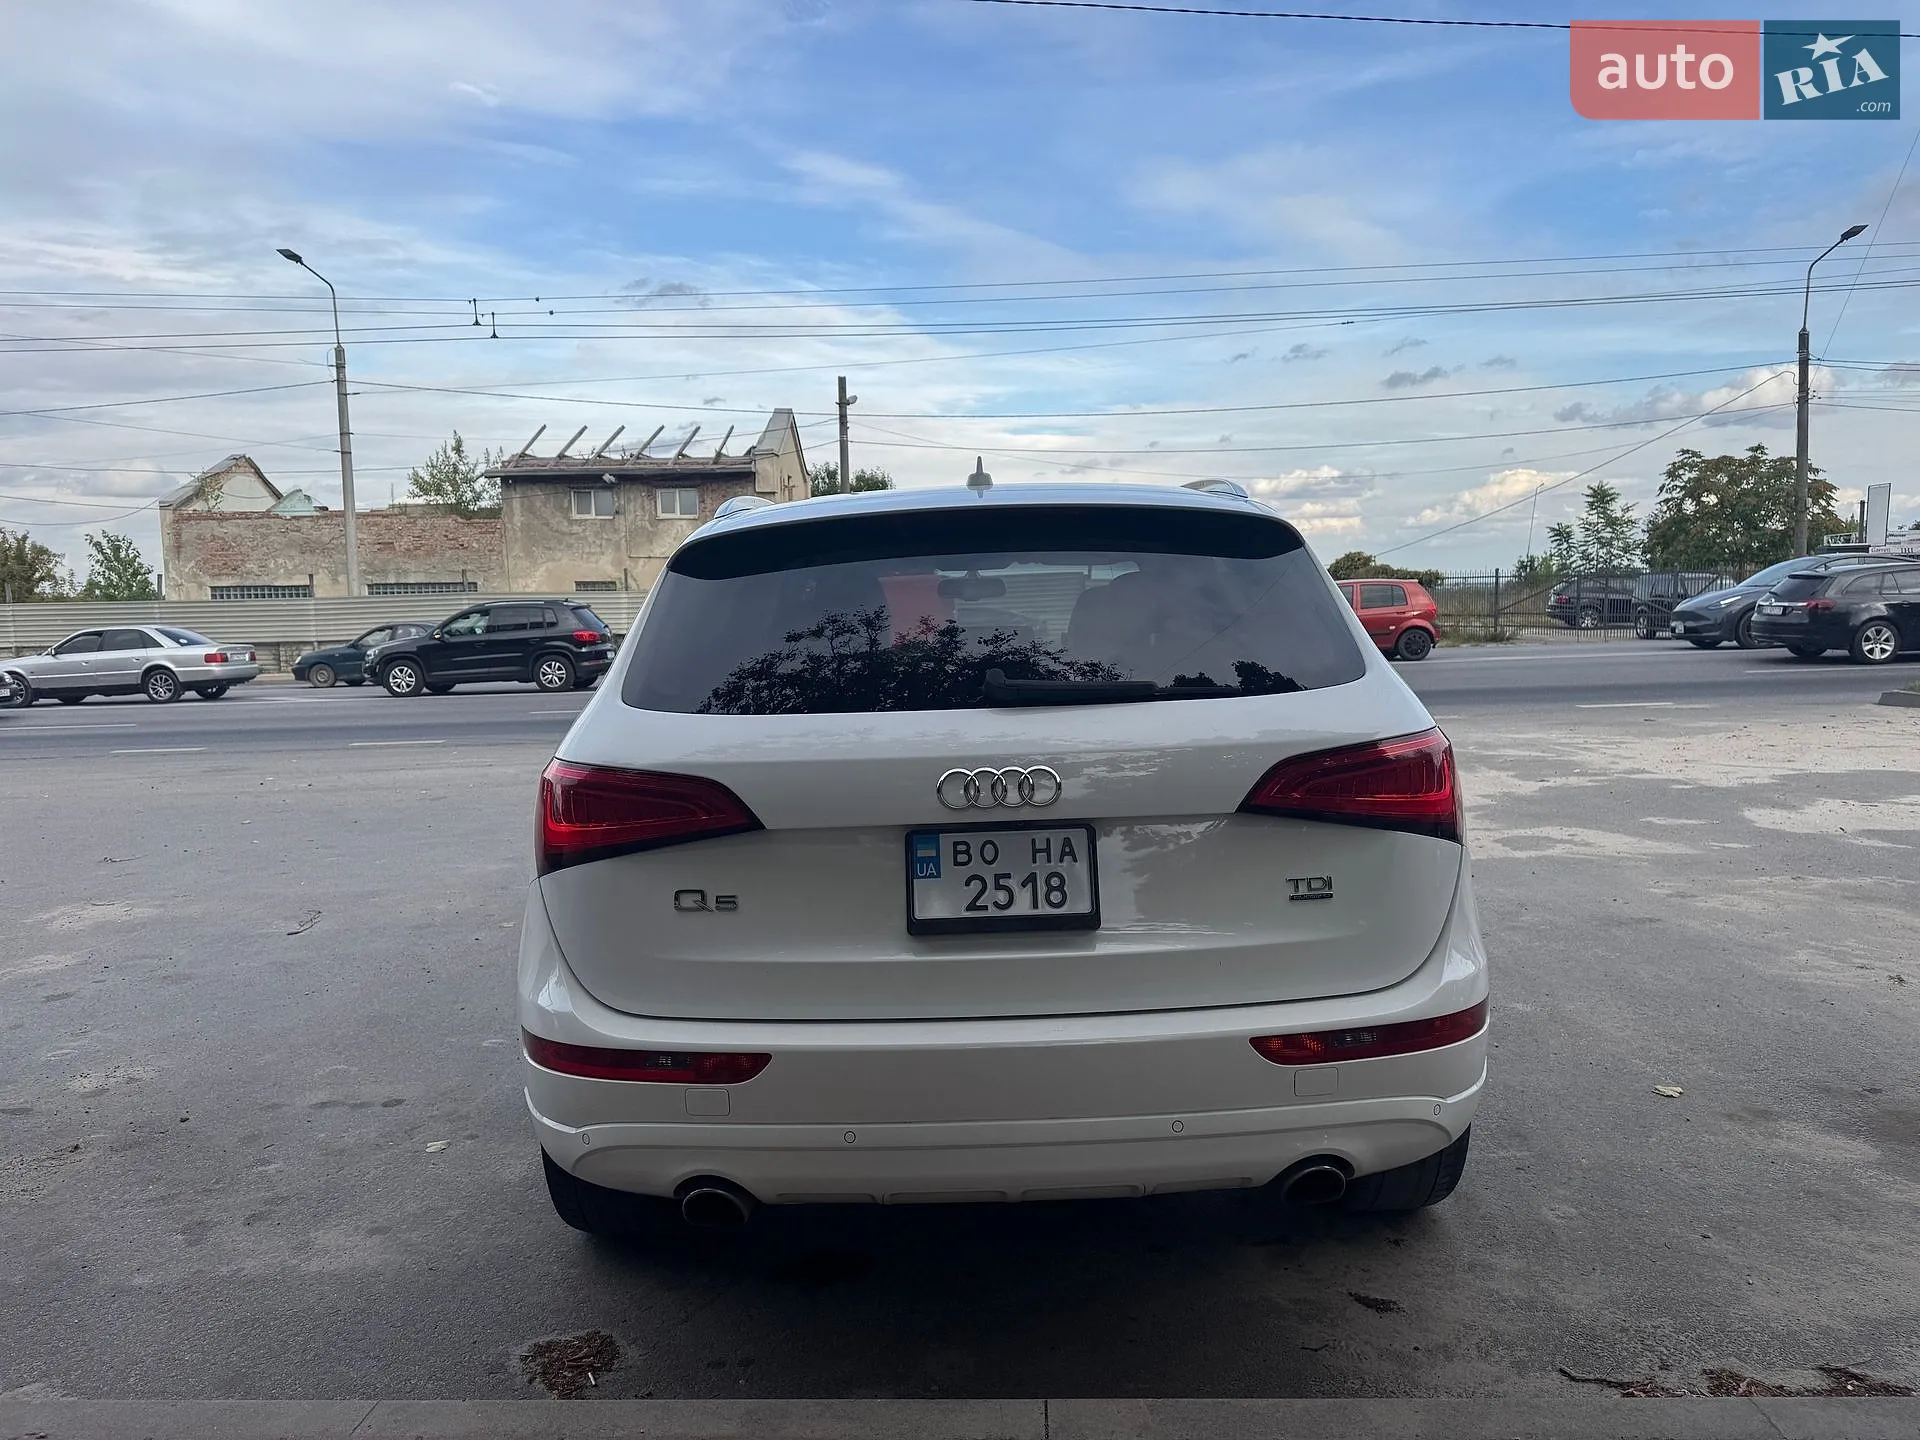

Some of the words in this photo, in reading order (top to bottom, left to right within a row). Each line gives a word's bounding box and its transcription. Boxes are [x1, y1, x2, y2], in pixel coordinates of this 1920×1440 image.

[952, 839, 1000, 867] BO
[1031, 836, 1079, 864] HA
[916, 863, 937, 877] UA
[964, 871, 1068, 912] 2518
[1285, 875, 1333, 892] TDI
[673, 889, 738, 912] Q5
